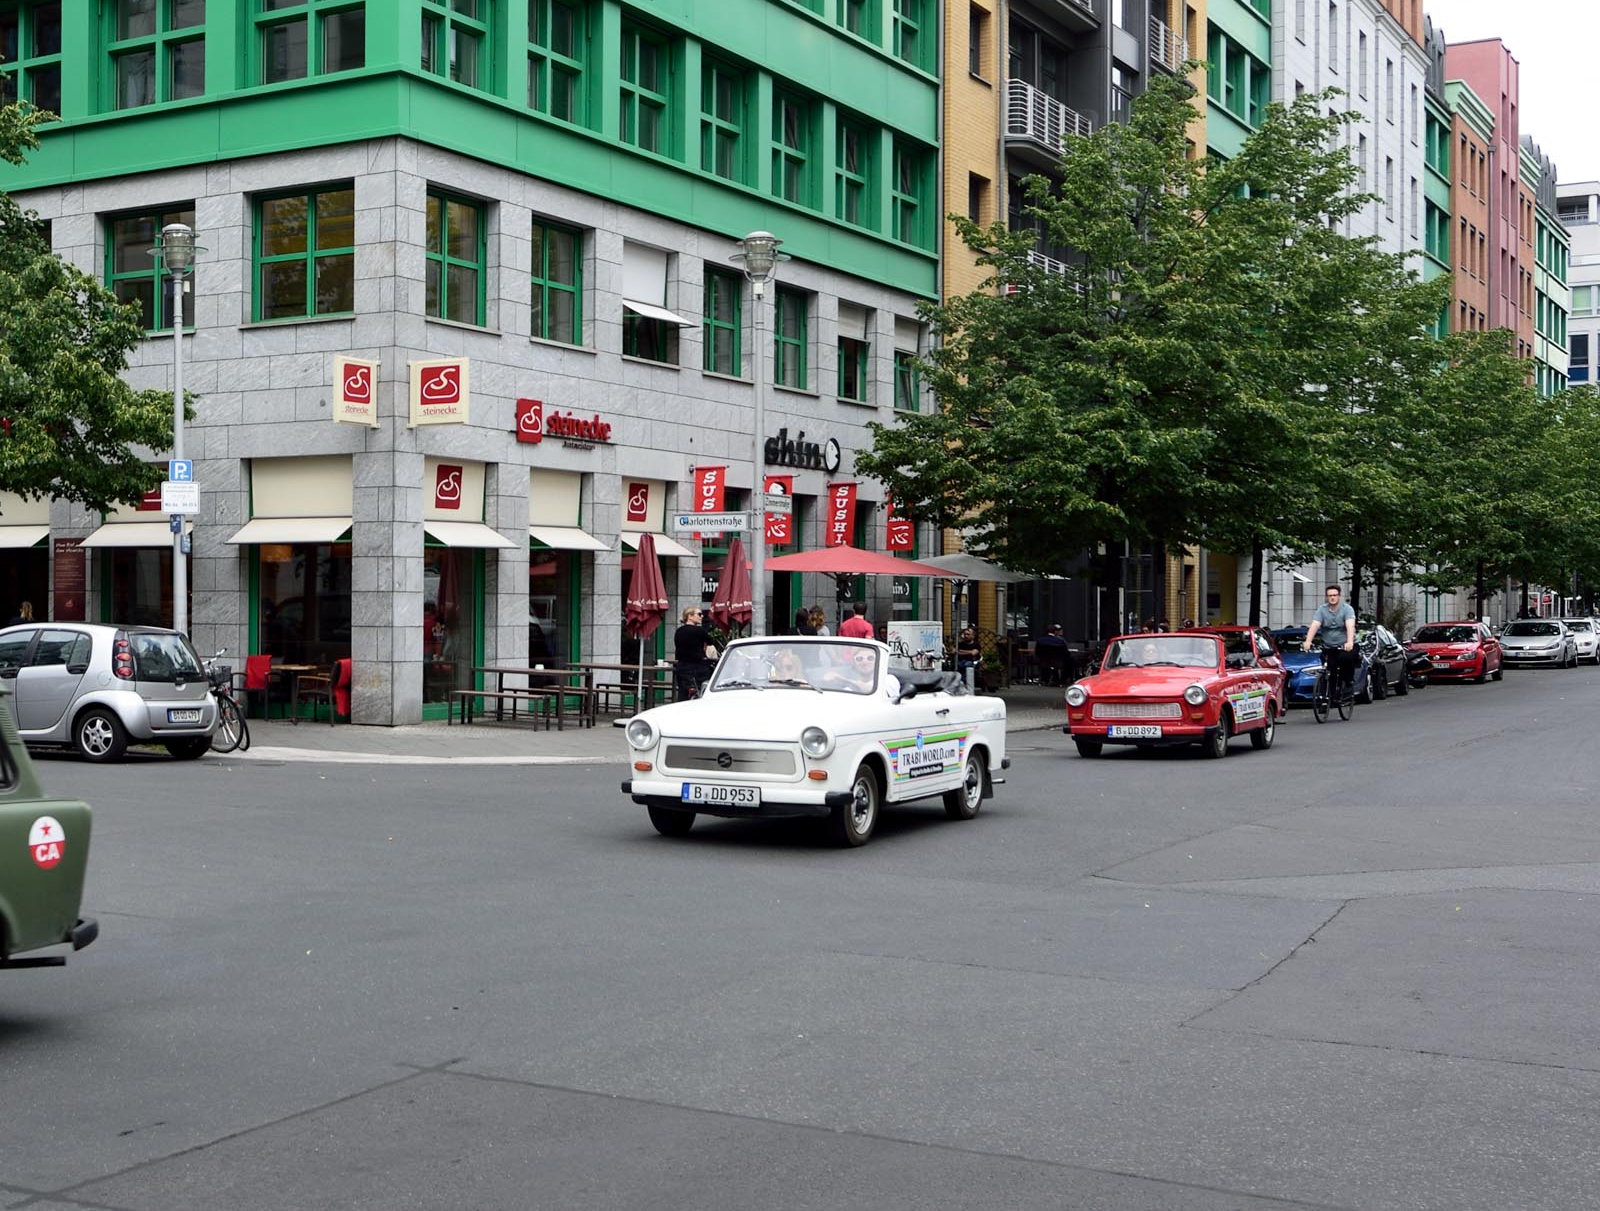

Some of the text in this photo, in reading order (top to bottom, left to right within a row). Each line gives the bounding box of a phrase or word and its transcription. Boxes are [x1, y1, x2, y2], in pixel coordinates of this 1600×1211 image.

[423, 406, 457, 417] steinecke
[546, 411, 612, 442] steinecke
[702, 470, 717, 511] SUS
[1116, 727, 1157, 735] B DD 892
[903, 747, 956, 766] TRABI WORLD.com
[694, 786, 754, 802] B DD 953
[35, 843, 61, 862] CA
